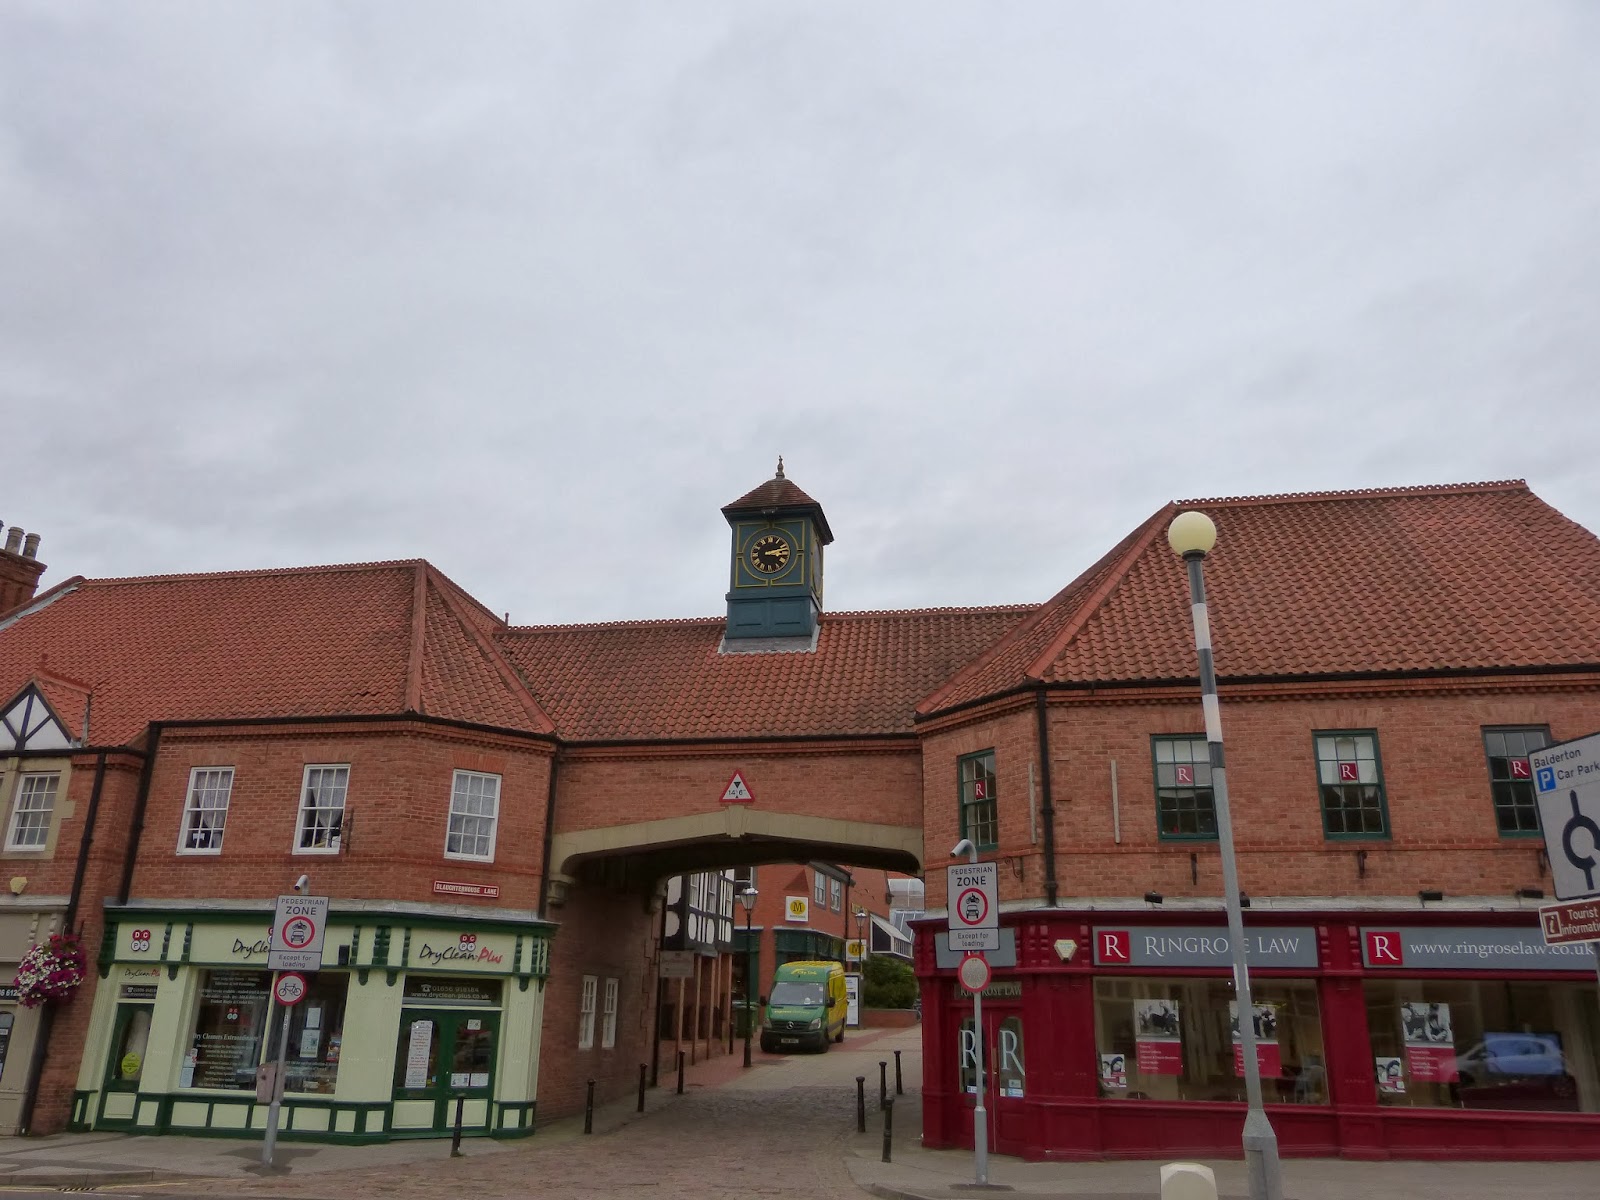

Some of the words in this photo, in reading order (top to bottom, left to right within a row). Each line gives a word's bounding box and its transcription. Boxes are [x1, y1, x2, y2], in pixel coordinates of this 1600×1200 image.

[1534, 749, 1582, 768] Balderton
[1178, 768, 1191, 782] R
[1341, 764, 1356, 779] R
[1511, 760, 1528, 776] R
[1540, 770, 1551, 789] P
[1557, 769, 1575, 780] Car
[1577, 761, 1600, 776] Park
[975, 783, 984, 796] R
[951, 866, 992, 875] PEDESTRIAN
[957, 876, 986, 887] ZONE
[436, 883, 481, 894] SLAUGHTERHOUSE
[484, 887, 497, 895] LANE
[286, 906, 317, 915] ZONE
[1567, 906, 1599, 920] Tourist
[957, 931, 978, 940] Except
[961, 940, 984, 948] loading
[1103, 934, 1128, 959] R
[1144, 936, 1250, 957] RINGROE
[1258, 936, 1300, 953] LAW
[1373, 936, 1399, 961] R
[1409, 941, 1594, 958] www.ringroselaw.co.uk
[1000, 1029, 1026, 1076] R
